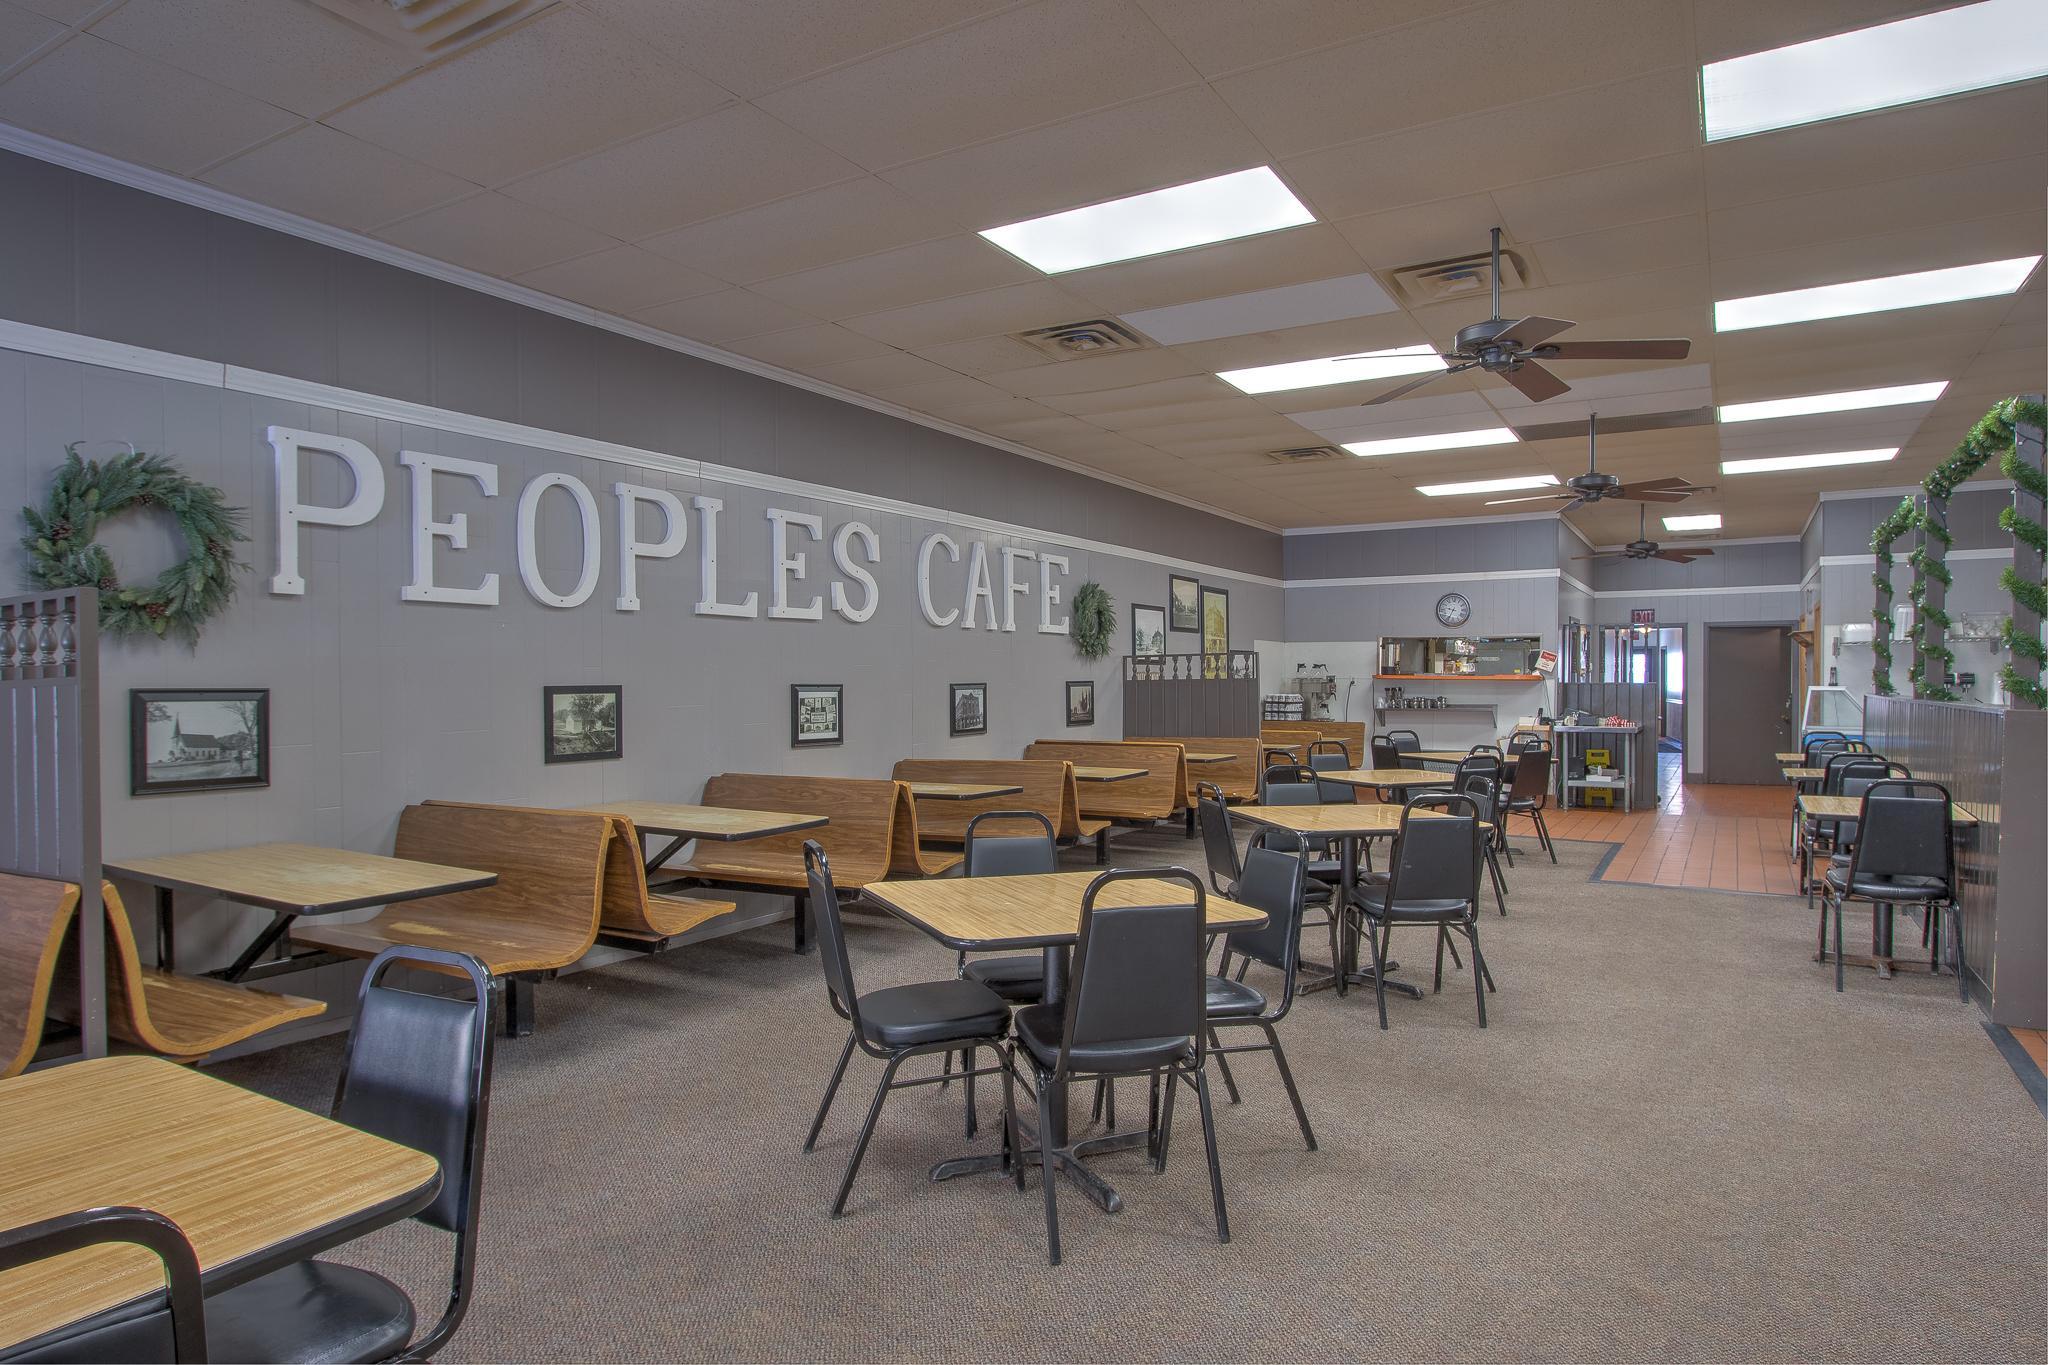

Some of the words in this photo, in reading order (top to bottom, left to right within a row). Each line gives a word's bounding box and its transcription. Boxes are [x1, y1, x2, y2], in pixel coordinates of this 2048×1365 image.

[267, 425, 881, 623] PEOPLES
[918, 532, 1070, 635] CAFE
[1634, 610, 1653, 623] EXIT
